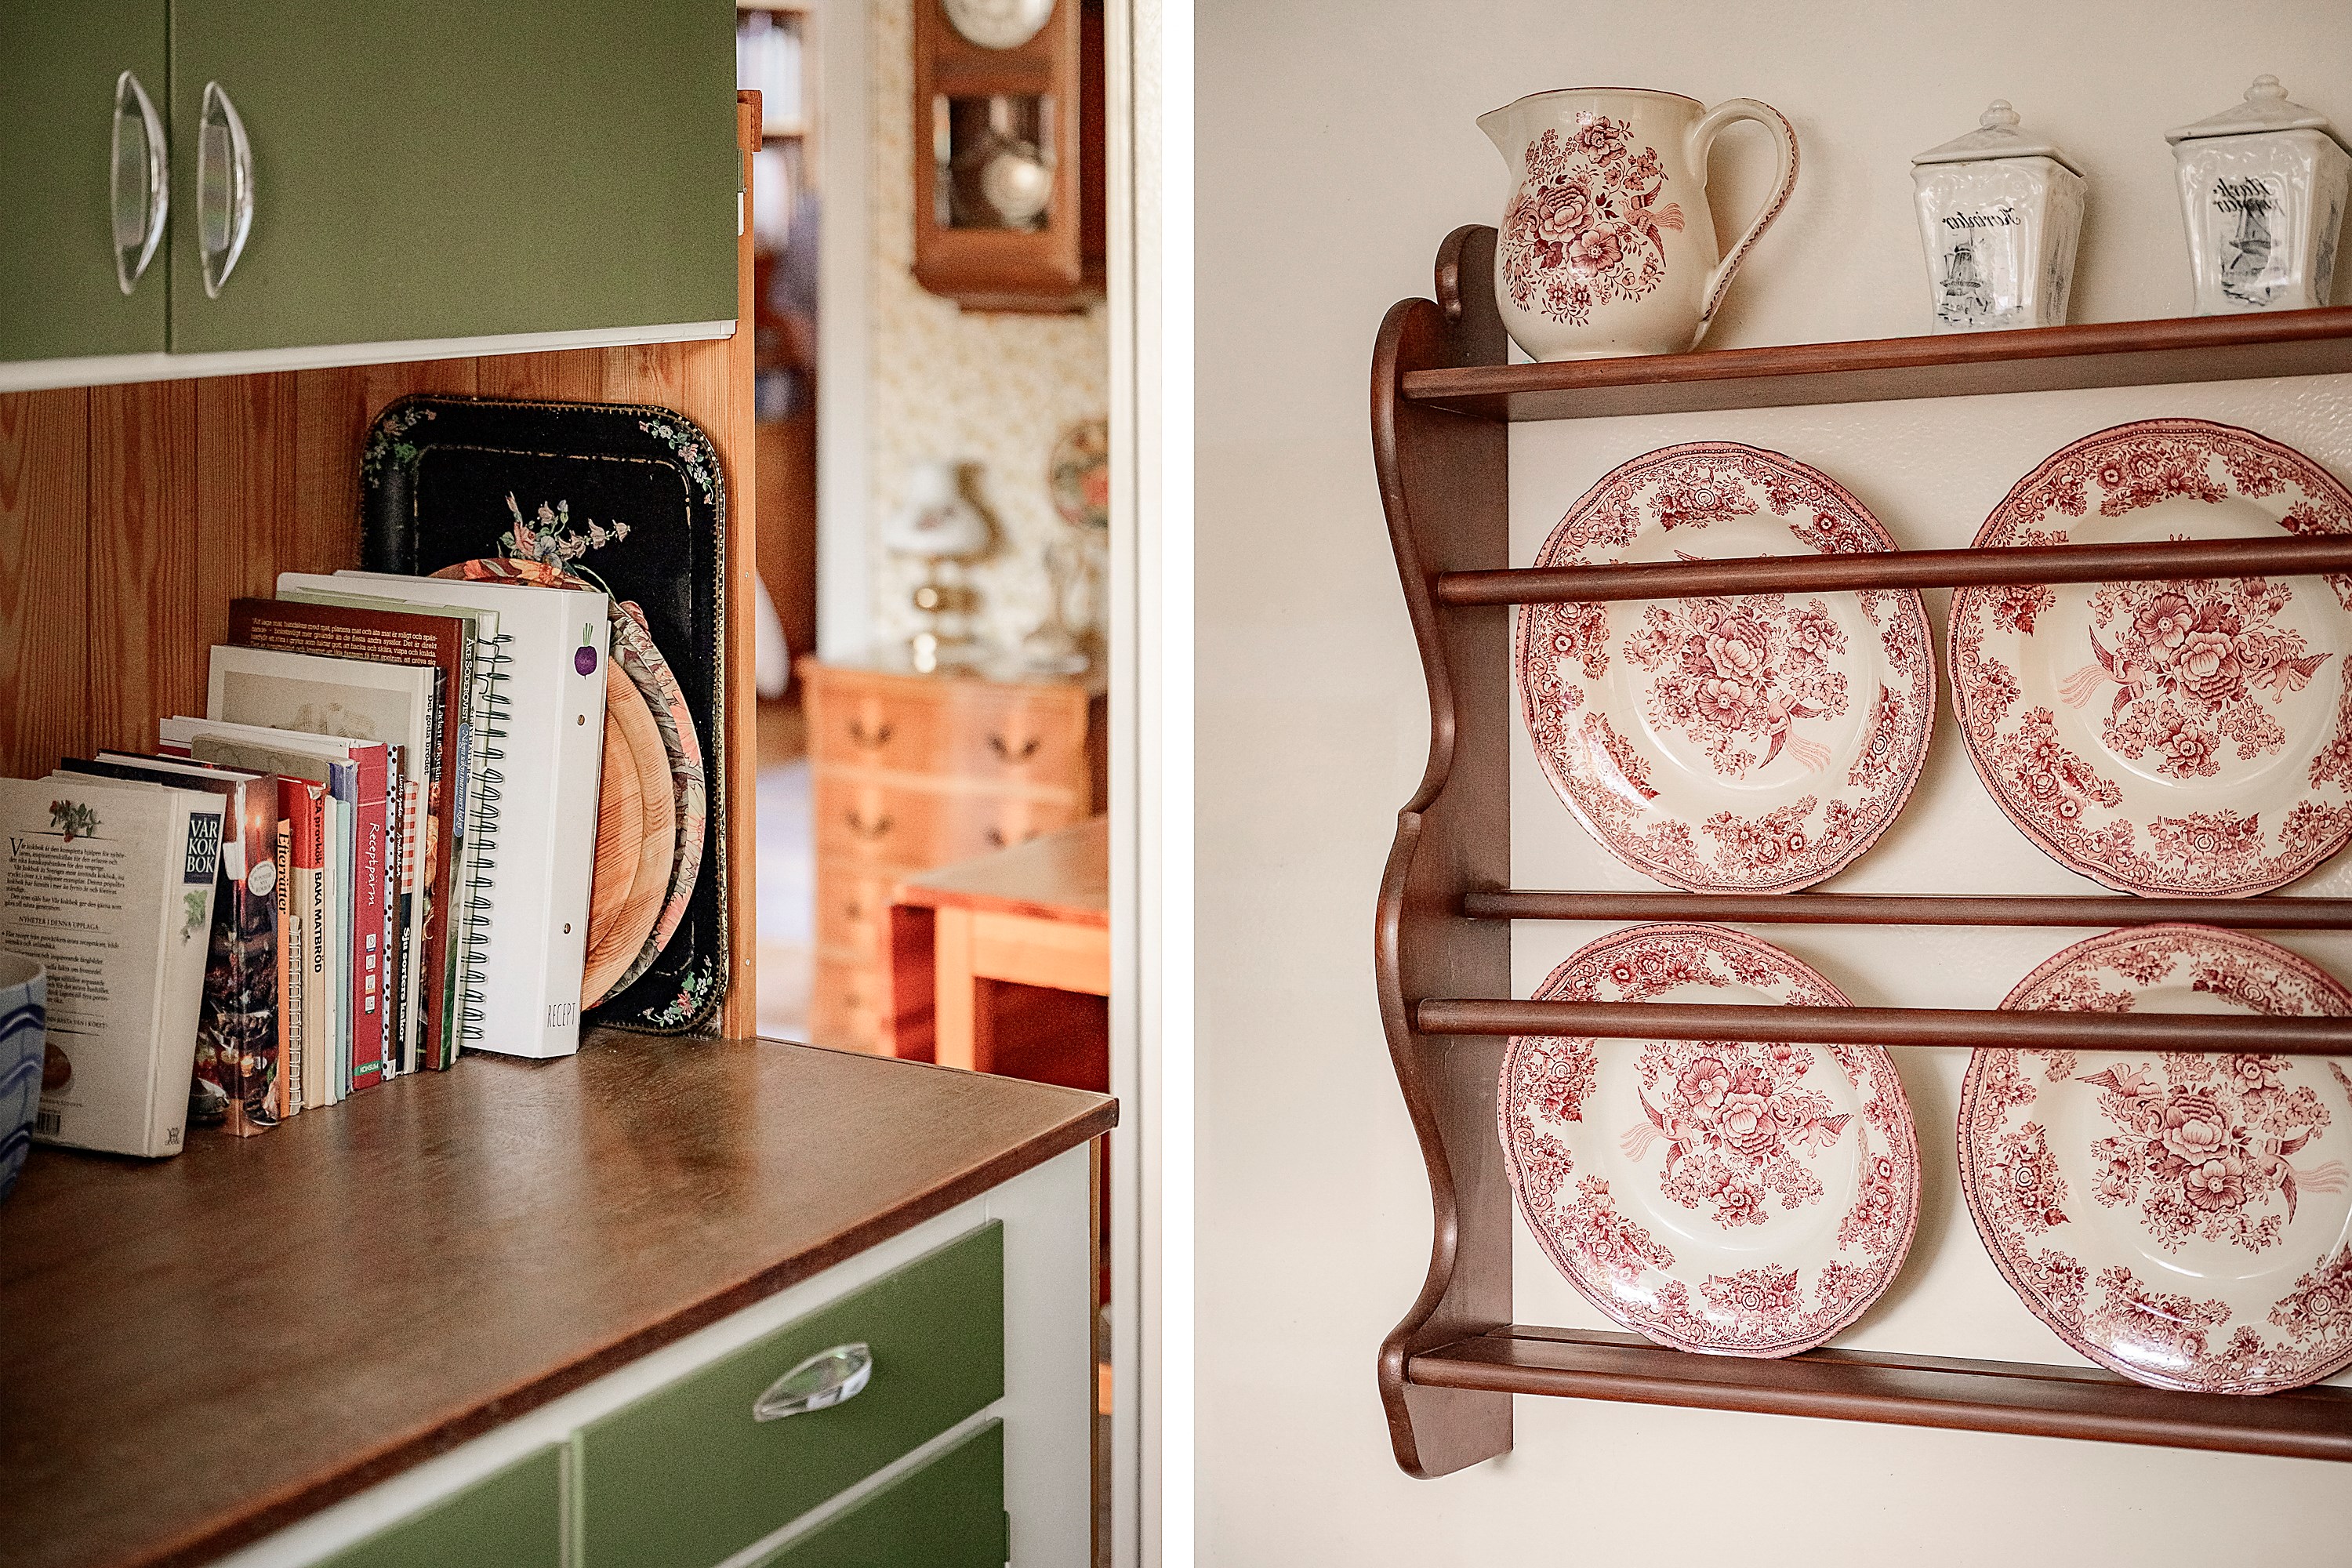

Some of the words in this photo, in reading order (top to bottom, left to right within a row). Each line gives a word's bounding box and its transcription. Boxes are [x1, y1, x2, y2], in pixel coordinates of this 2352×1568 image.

[462, 659, 473, 720] SÖDERQVIST
[433, 752, 442, 789] kyckling
[314, 793, 323, 815] CA
[191, 818, 217, 837] VÅR
[314, 817, 324, 865] provkök
[188, 838, 216, 855] KOK
[187, 856, 214, 873] BOK
[278, 833, 289, 915] Efterrätter
[365, 822, 380, 906] Receptpärm
[314, 909, 325, 973] MATBRÖD
[402, 927, 411, 950] Sju
[547, 1003, 575, 1028] RECEPT
